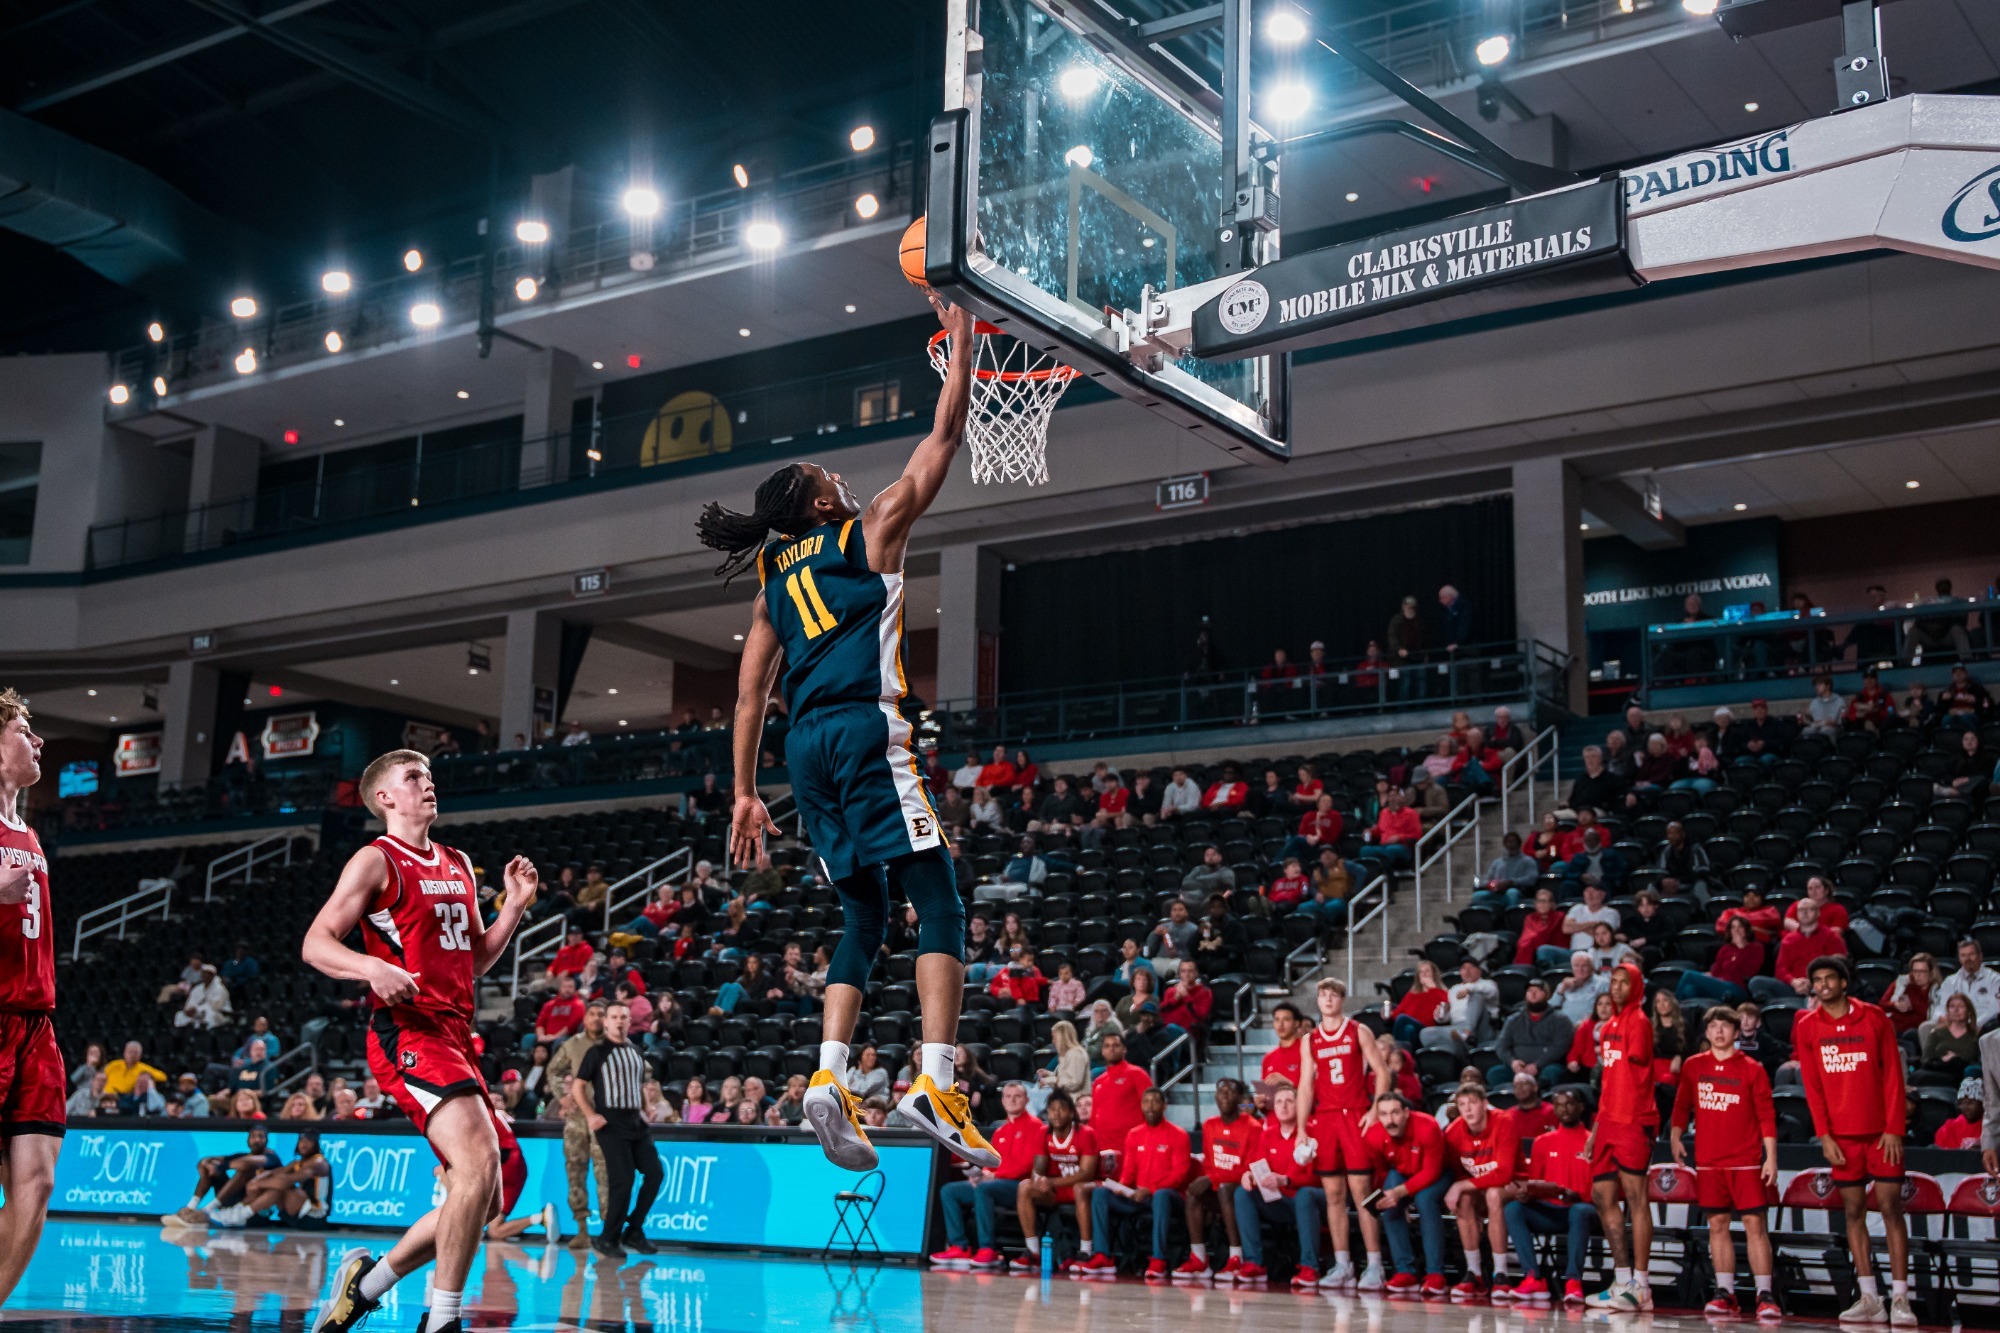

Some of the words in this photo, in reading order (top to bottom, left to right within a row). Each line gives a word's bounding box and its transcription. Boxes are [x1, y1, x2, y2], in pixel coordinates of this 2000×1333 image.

[1627, 131, 1791, 203] PALDING
[1348, 219, 1513, 278] CLARKSVILLE
[1279, 281, 1365, 323] MOBILE
[1371, 270, 1416, 301] MIX
[1422, 263, 1440, 288] &
[1447, 226, 1592, 282] MATERIALS
[1168, 482, 1197, 501] 116
[774, 537, 815, 573] TAYLOR
[581, 574, 601, 591] 115
[1620, 587, 1650, 602] LIKE
[1653, 583, 1673, 598] NO
[1675, 578, 1721, 595] OTHER
[1724, 573, 1771, 591] VODKA
[785, 565, 838, 640] 11
[419, 880, 450, 894] AUSTIN
[22, 881, 40, 939] 3
[434, 902, 471, 951] 32
[1821, 1045, 1839, 1054] NO
[1823, 1052, 1868, 1064] MATTER
[1329, 1058, 1345, 1084] 2
[1824, 1062, 1858, 1073] WHAT
[1698, 1082, 1714, 1092] NO
[1699, 1091, 1740, 1104] MATTER
[1699, 1101, 1729, 1111] WHAT
[93, 1140, 164, 1183] JOINT
[336, 1146, 416, 1192] JOINT
[65, 1185, 153, 1206] chiropractic
[333, 1197, 405, 1217] opractic
